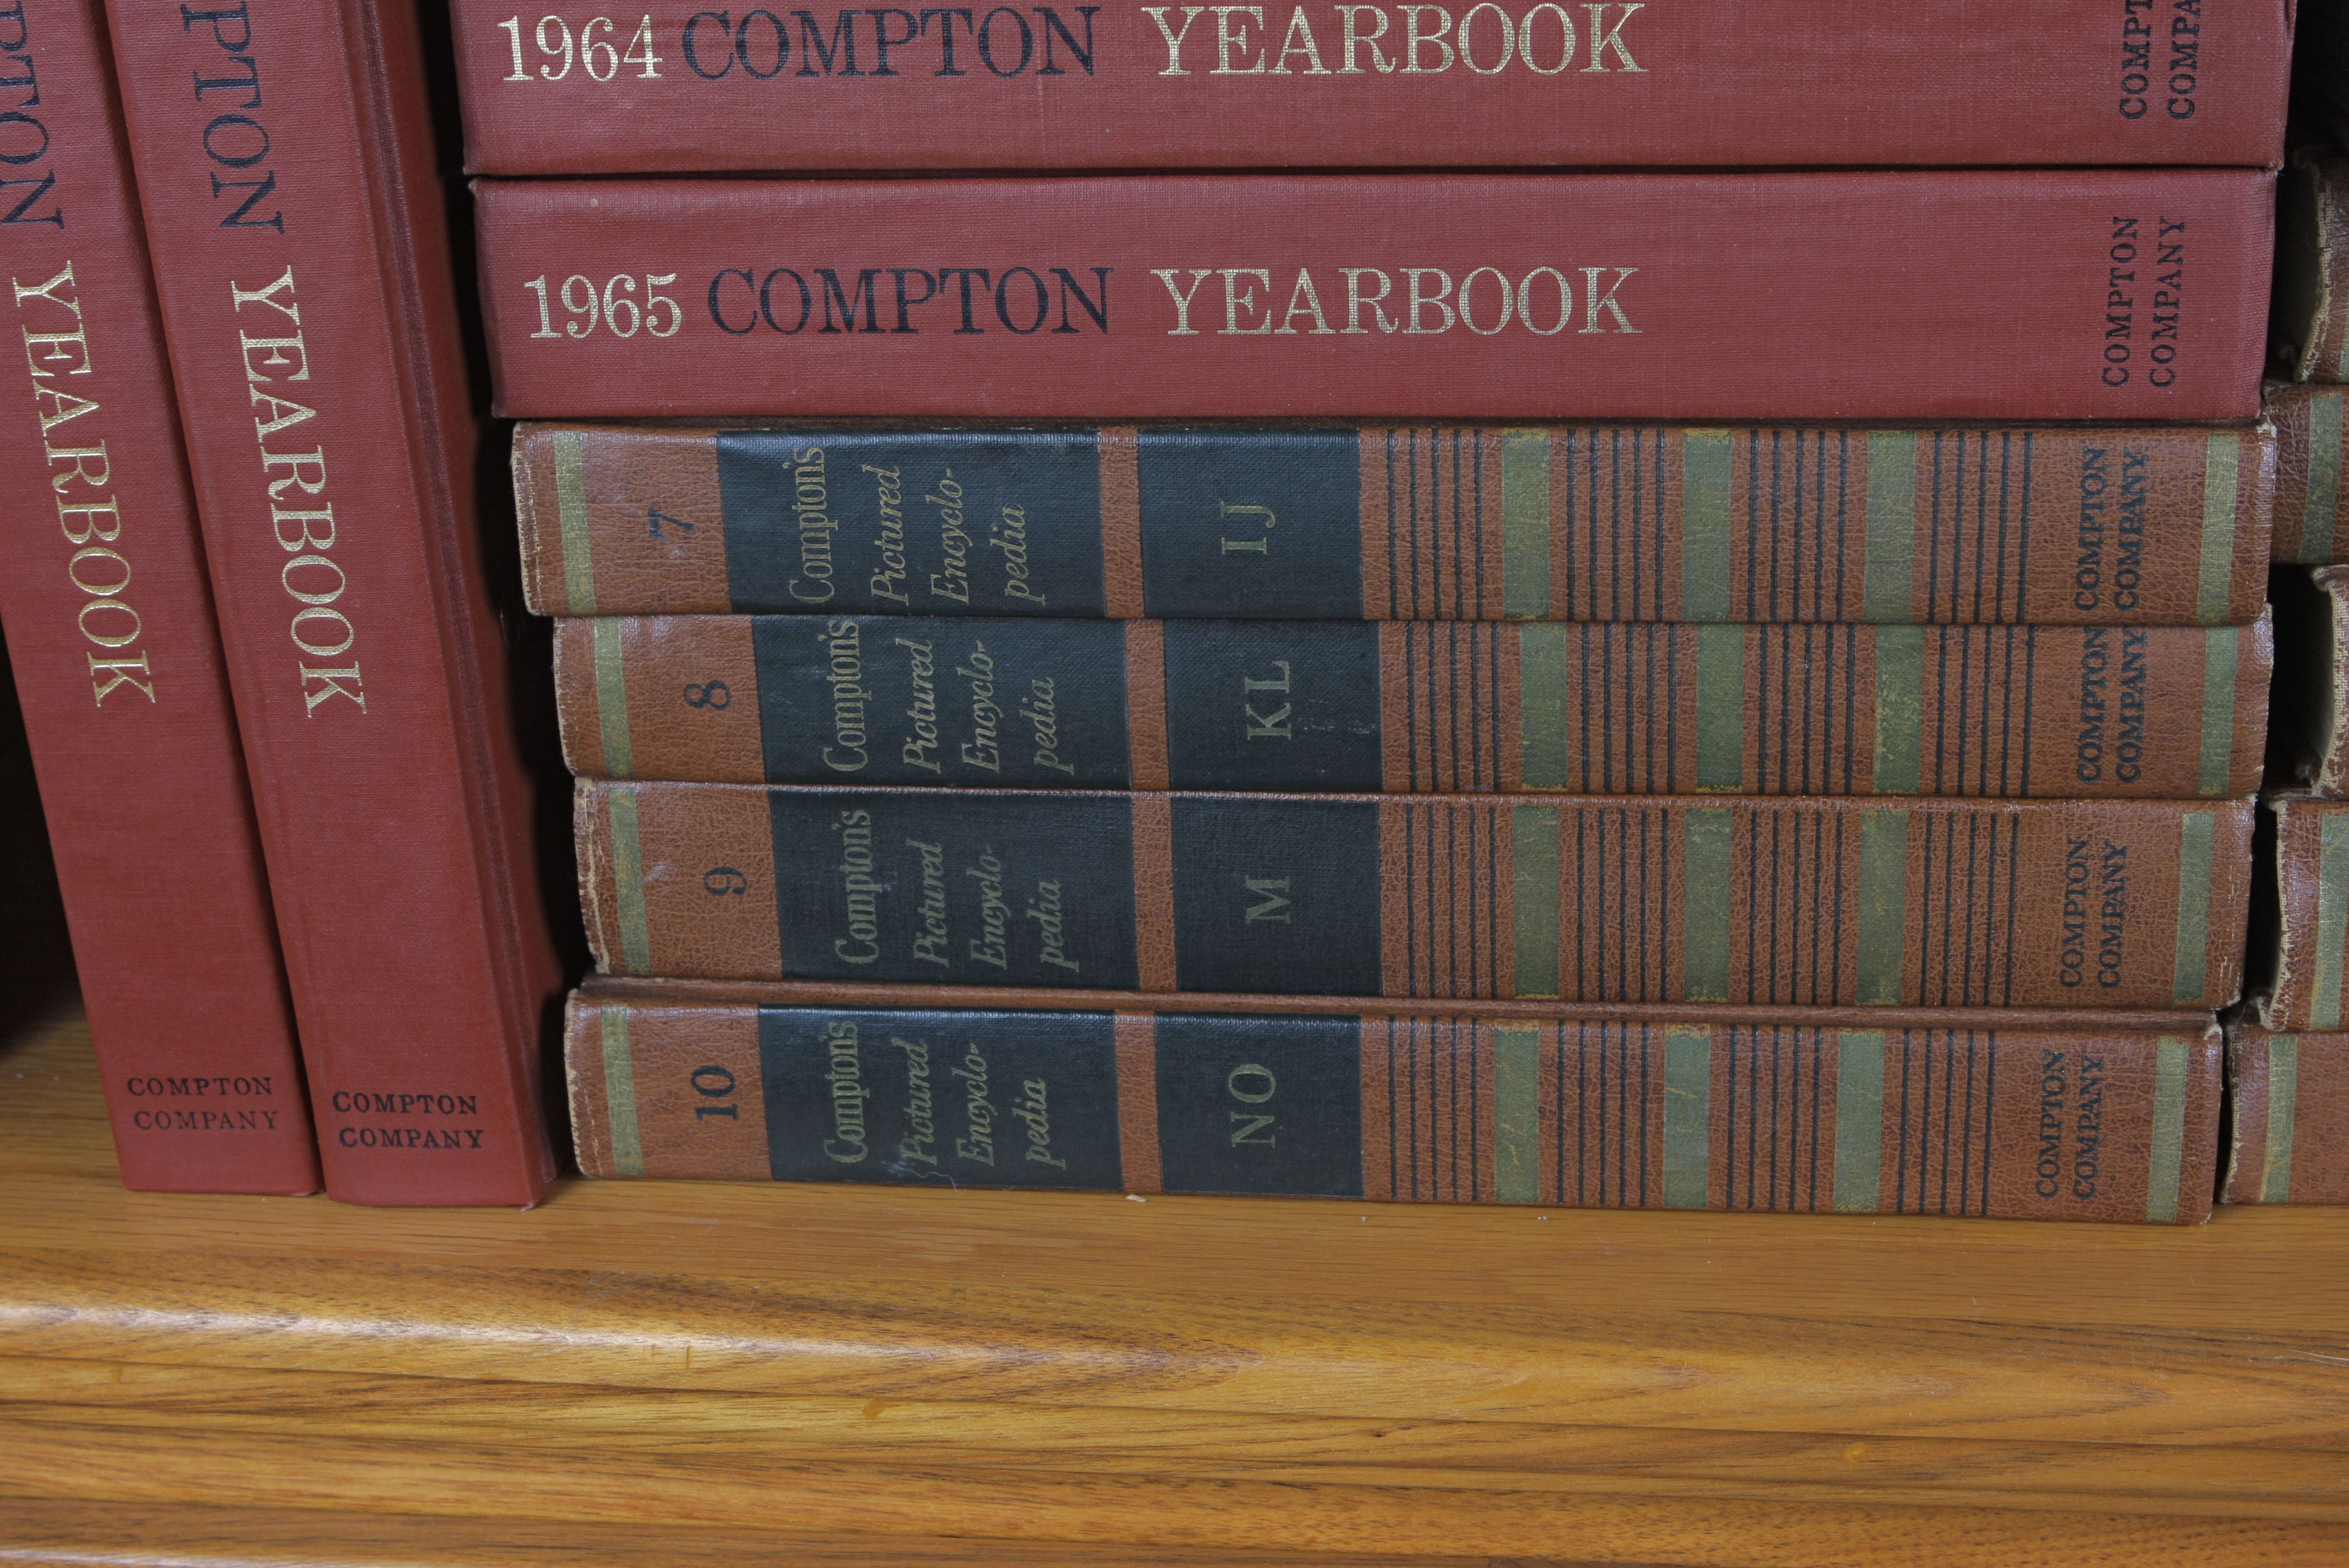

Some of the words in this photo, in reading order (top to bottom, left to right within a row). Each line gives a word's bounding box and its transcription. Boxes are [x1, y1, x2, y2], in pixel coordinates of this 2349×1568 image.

[497, 14, 664, 82] 1964
[682, 7, 1100, 80] COMPTON
[1140, 3, 1648, 75] YEARBOOK
[2166, 0, 2201, 119] COMPA
[523, 272, 683, 339] 1965
[707, 267, 1114, 334] COMPTON
[1150, 266, 1643, 336] YEARBOOK
[2101, 216, 2139, 387] COMPTON
[2150, 215, 2186, 389] COMPANY
[13, 259, 156, 707] YEARBOOK
[231, 265, 367, 717] YEARBOOK
[648, 508, 694, 540] 7
[782, 446, 838, 604] Compton's
[862, 464, 910, 606] Pictured
[925, 466, 973, 606] Encyclo-
[1220, 501, 1276, 554] IJ
[2075, 445, 2109, 611] COMPTON
[2114, 446, 2149, 611] COMPANY
[989, 505, 1045, 606] pedia
[684, 680, 732, 711] 8
[823, 620, 872, 771] Compton's
[895, 638, 940, 773] Pictured
[956, 640, 1003, 774] Encyclo-
[1019, 677, 1074, 775] pedia
[1244, 660, 1293, 741] KL
[2077, 627, 2109, 783] COMPTON
[2115, 626, 2148, 783] COMPANY
[703, 867, 747, 897] 9
[832, 808, 884, 965] Compton's
[907, 837, 950, 968] Pictured
[966, 845, 1010, 970] Encyclo-
[1027, 879, 1079, 972] pedia
[1245, 874, 1291, 924] M
[2060, 838, 2090, 988] COMPTON
[2097, 838, 2127, 988] COMPANY
[127, 1077, 273, 1096] COMPTON
[133, 1110, 279, 1131] COMPANY
[333, 1092, 477, 1115] COMPTON
[339, 1128, 485, 1149] COMPANY
[690, 1064, 738, 1121] 10
[817, 1020, 871, 1163] Compton's
[891, 1038, 937, 1165] Pictured
[951, 1043, 997, 1168] Encyclo-
[1011, 1078, 1066, 1168] pedia
[1228, 1063, 1277, 1149] NO
[2035, 1049, 2067, 1198] COMPTON
[2073, 1053, 2105, 1200] COMPANY
